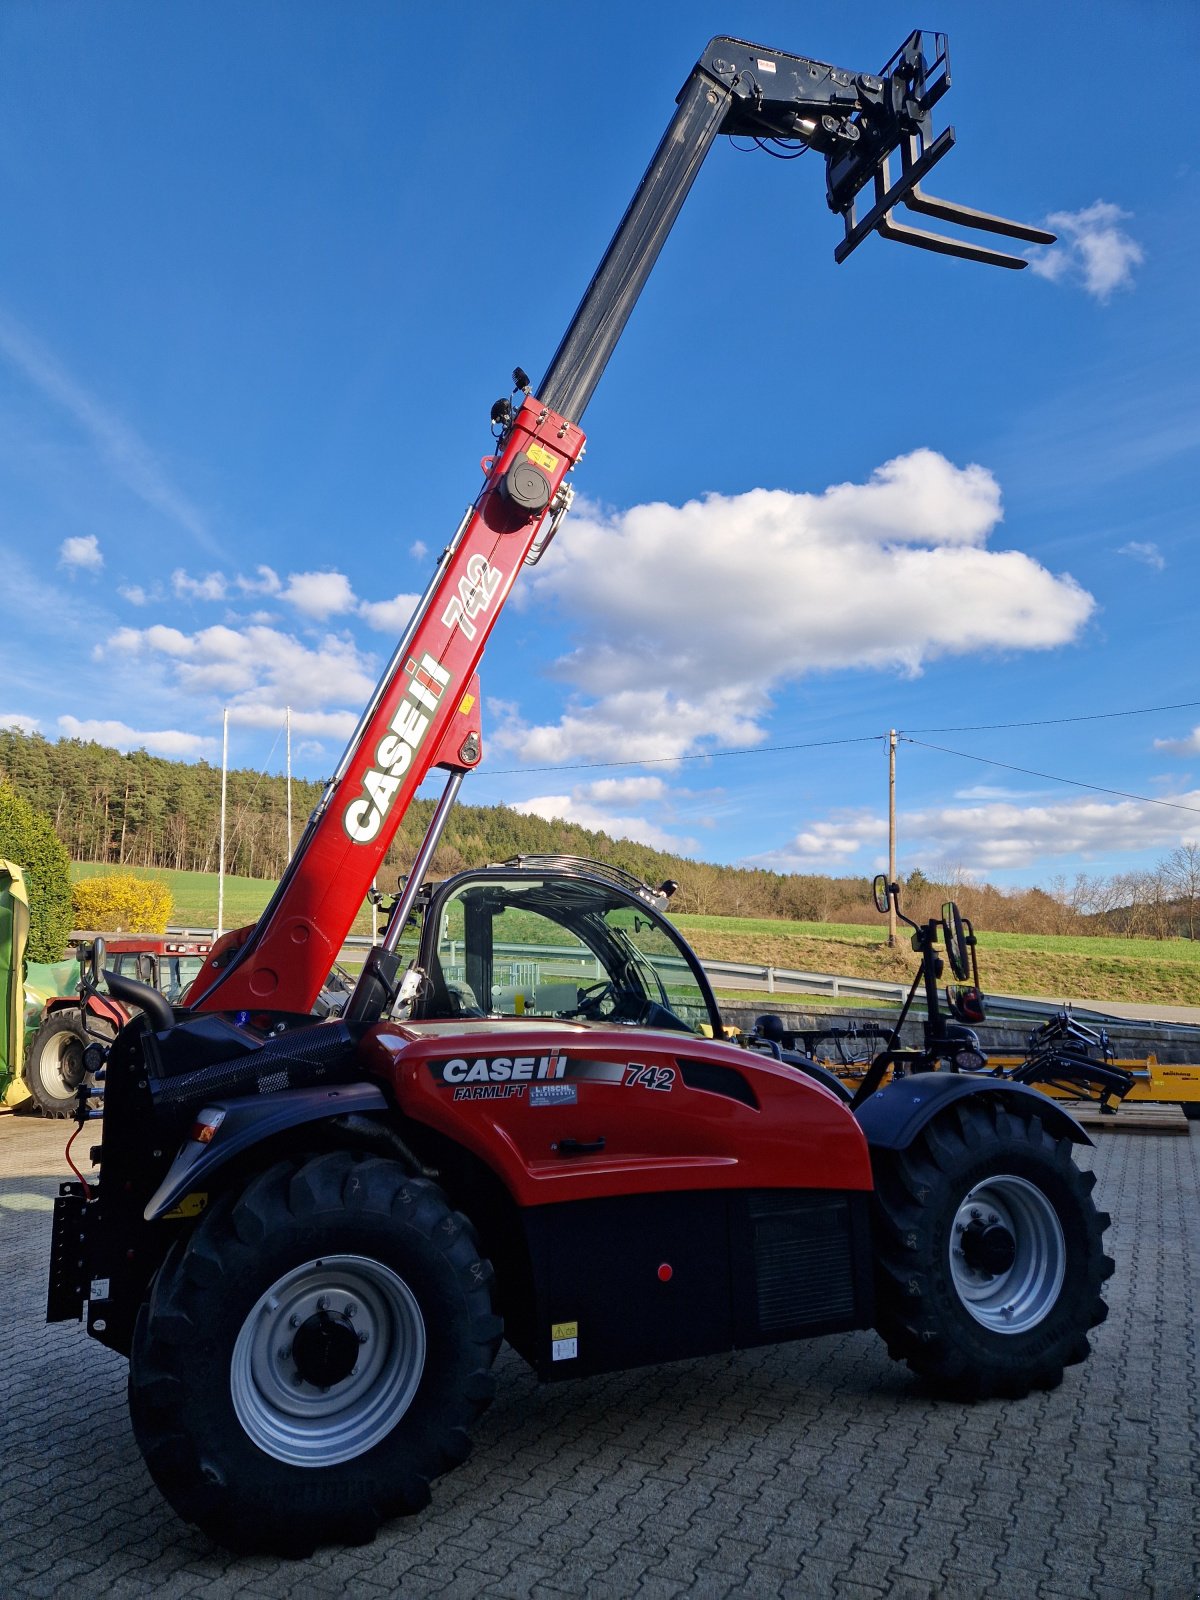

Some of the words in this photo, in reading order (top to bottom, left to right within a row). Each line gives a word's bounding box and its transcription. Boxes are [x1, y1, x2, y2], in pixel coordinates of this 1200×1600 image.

[441, 554, 502, 641] 742
[345, 698, 429, 844] CASE
[442, 1057, 535, 1082] CASE
[625, 1063, 676, 1092] 742
[453, 1084, 527, 1101] FARMLIFT
